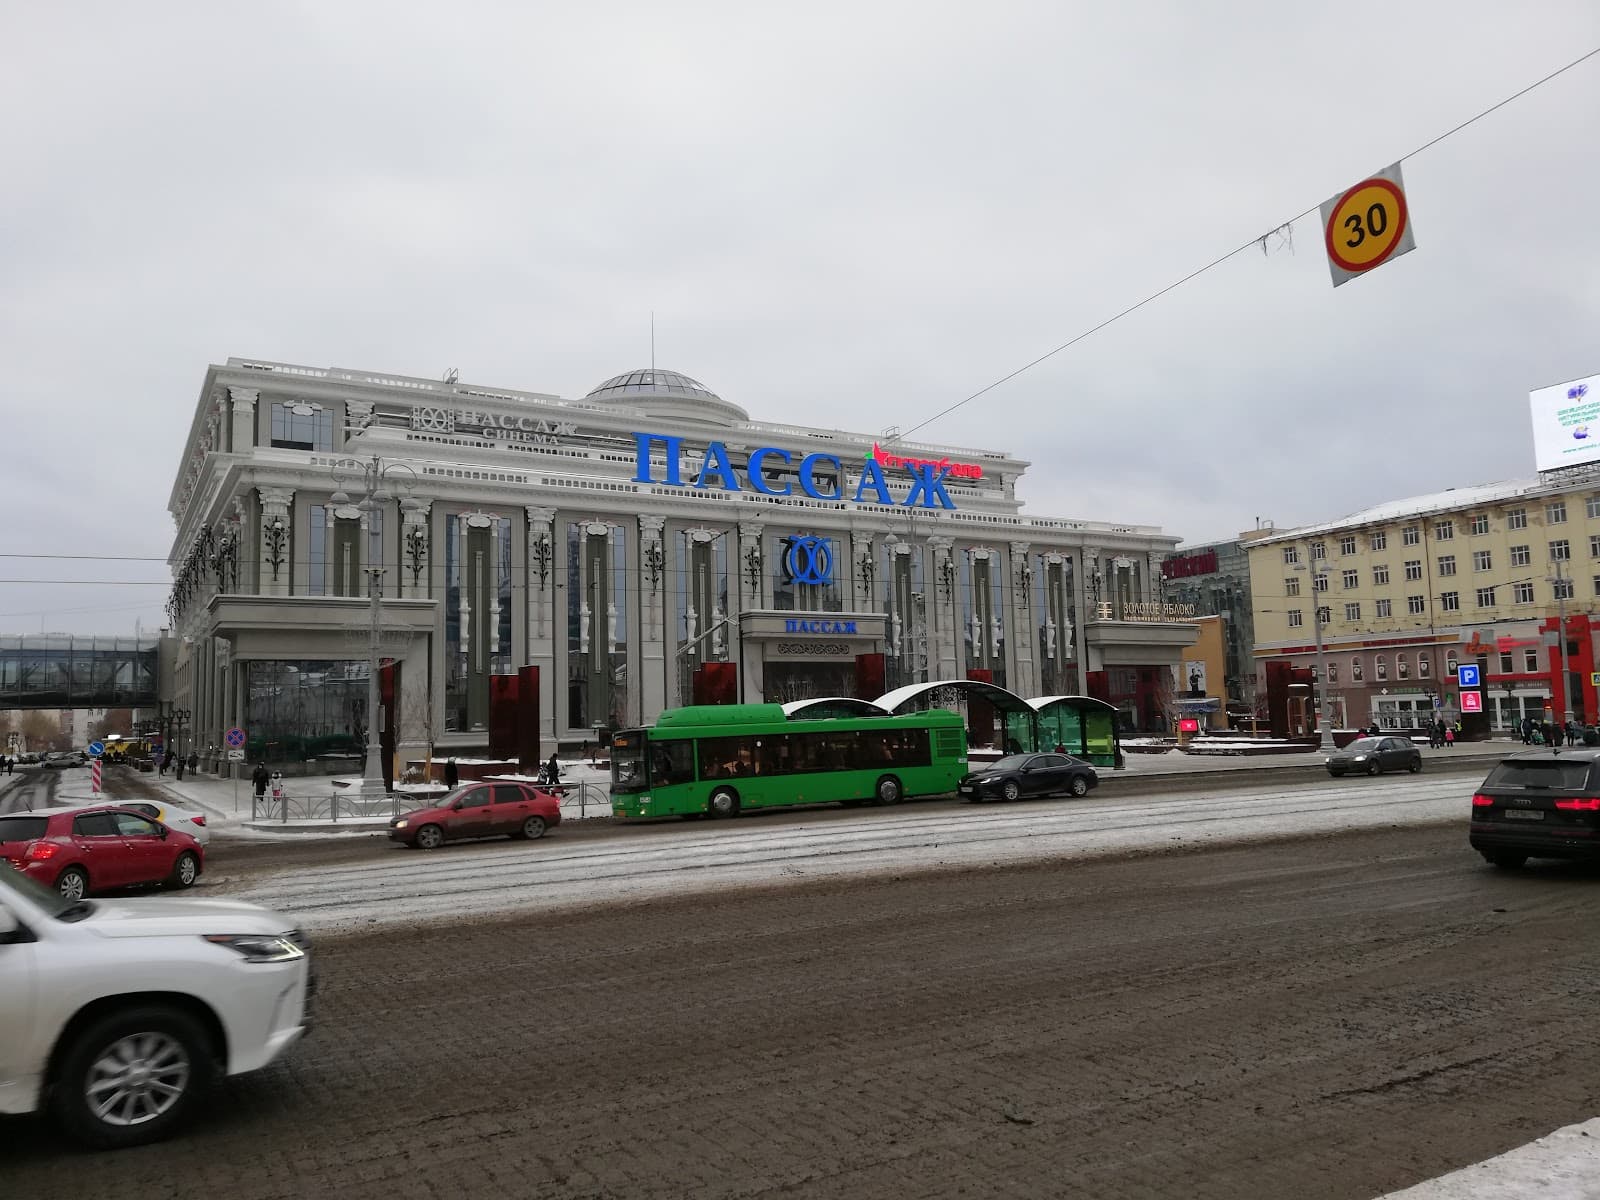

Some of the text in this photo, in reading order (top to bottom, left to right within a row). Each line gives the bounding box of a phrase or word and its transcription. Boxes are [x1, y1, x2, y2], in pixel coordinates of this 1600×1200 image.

[1344, 202, 1387, 248] 30
[457, 409, 577, 435] ПАССАЖ
[482, 428, 559, 445] СИНЕМА
[631, 432, 957, 510] ПАССАЖ
[1124, 602, 1195, 615] ЗОЛОТОЕ ЯБЛОКО
[784, 619, 857, 634] ПАССАЖ
[1463, 669, 1475, 683] P
